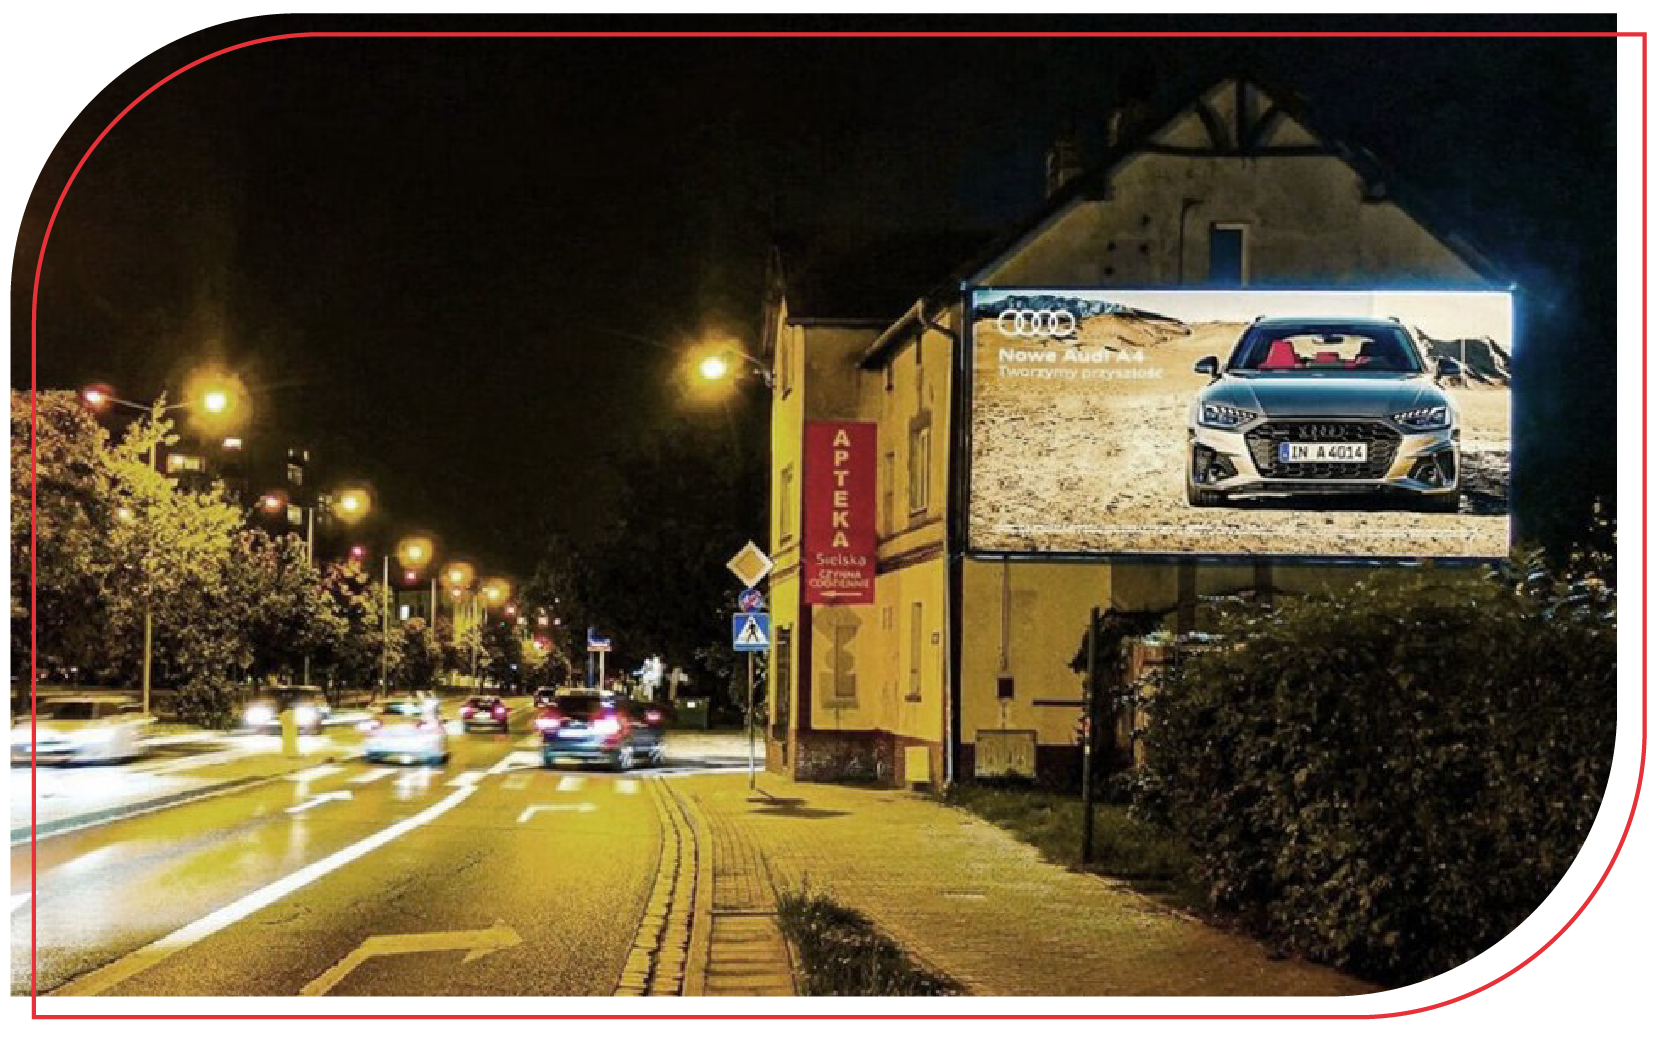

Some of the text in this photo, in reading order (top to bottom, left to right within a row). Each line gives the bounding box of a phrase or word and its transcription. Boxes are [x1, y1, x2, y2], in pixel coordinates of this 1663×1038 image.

[999, 349, 1143, 363] Nowe Audi A4
[999, 366, 1075, 379] Tworzymy
[1292, 445, 1307, 459] IN
[833, 429, 850, 547] APTEKA
[816, 552, 867, 566] Sielska
